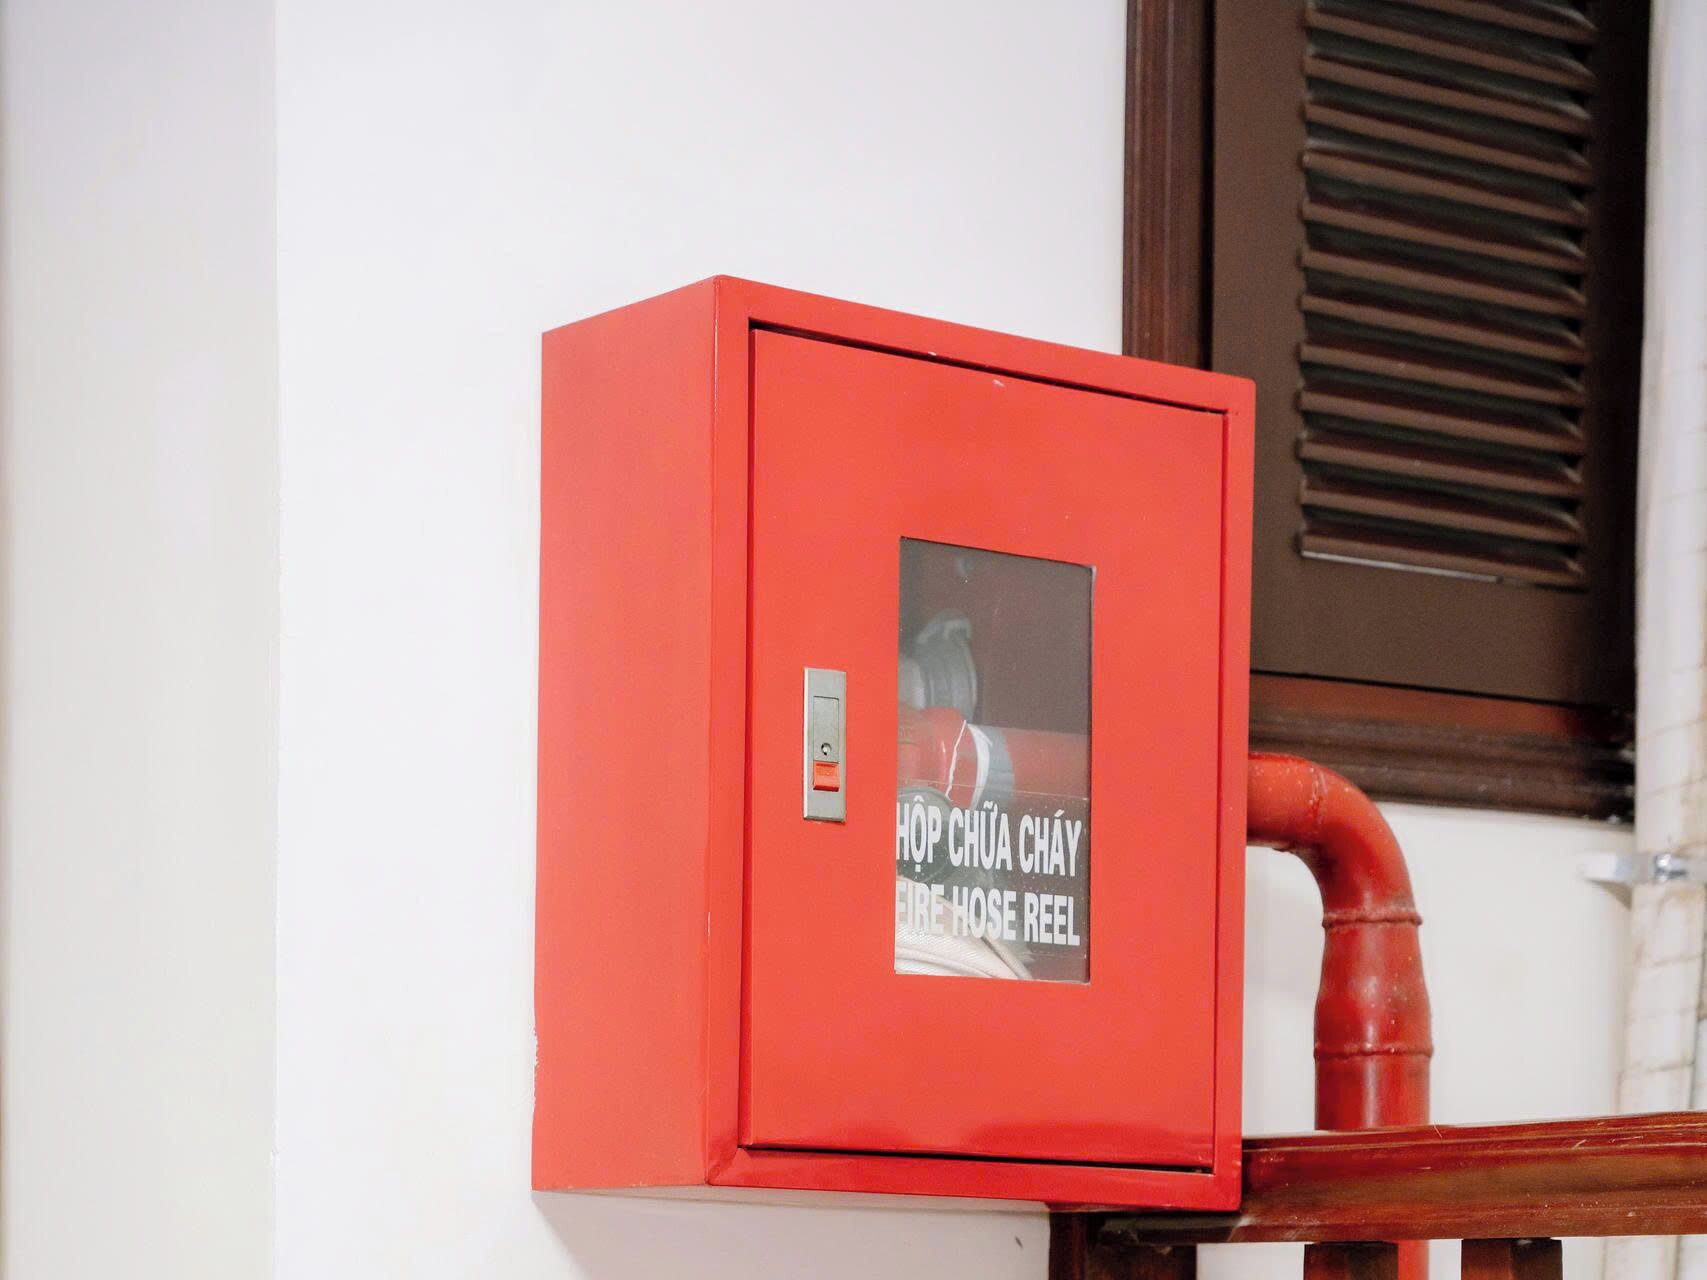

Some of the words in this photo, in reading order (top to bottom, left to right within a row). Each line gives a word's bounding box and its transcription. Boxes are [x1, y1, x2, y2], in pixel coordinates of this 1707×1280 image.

[896, 795, 942, 872] HỘP
[949, 801, 1012, 870] CHỮA
[1019, 809, 1082, 877] CHÁY
[952, 886, 1016, 941] HOSE
[1023, 892, 1080, 946] REEL
